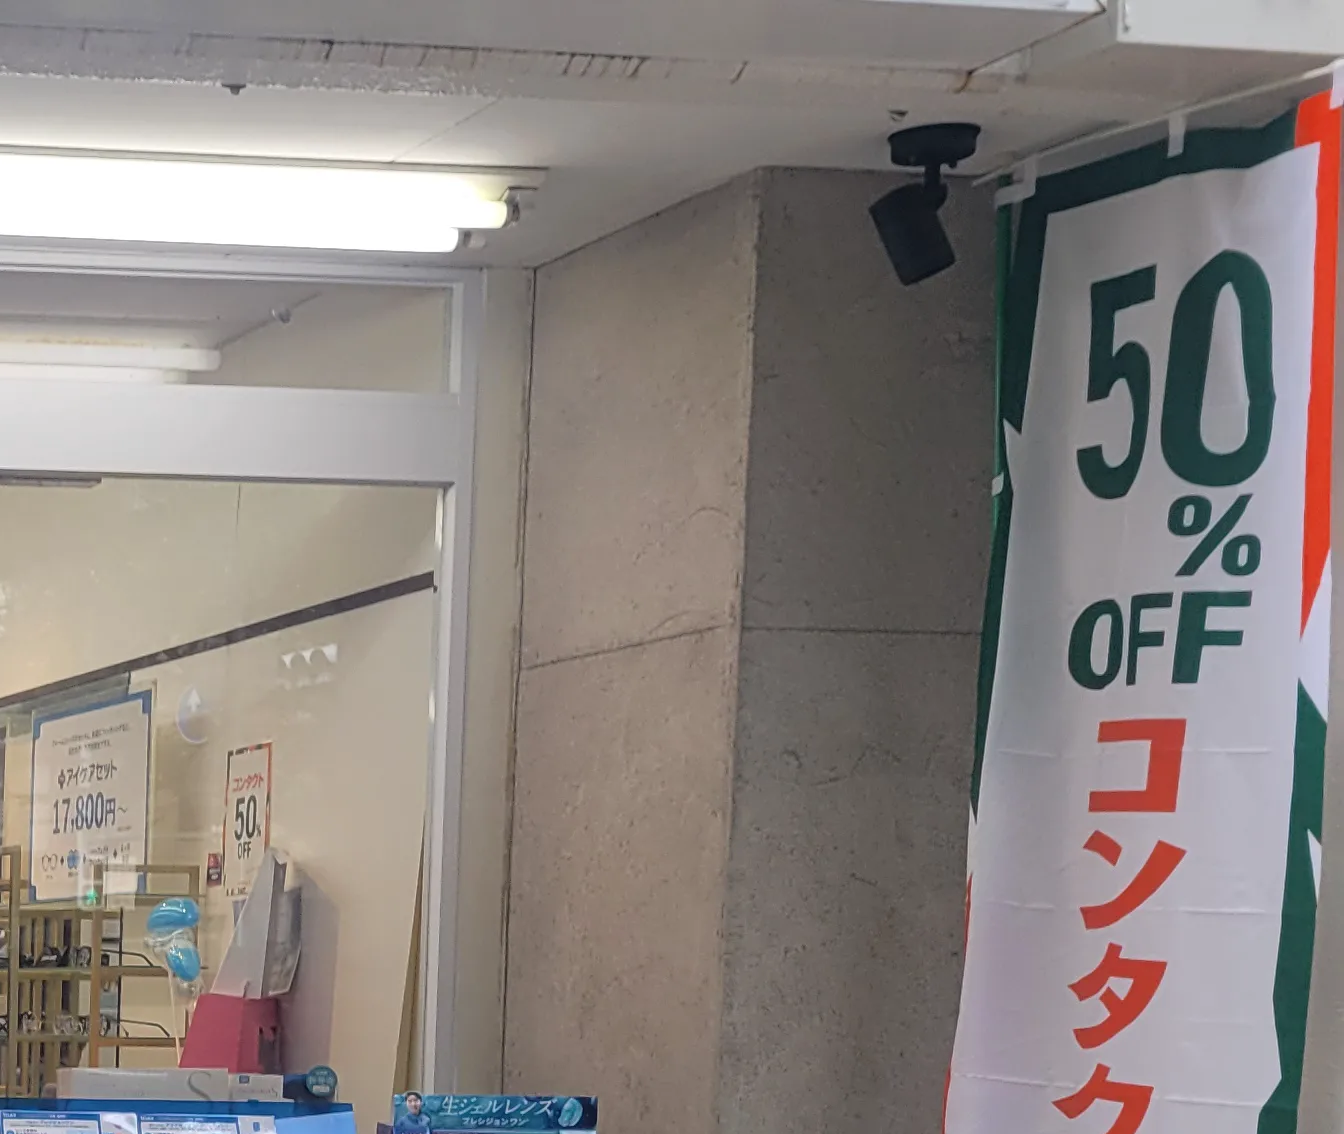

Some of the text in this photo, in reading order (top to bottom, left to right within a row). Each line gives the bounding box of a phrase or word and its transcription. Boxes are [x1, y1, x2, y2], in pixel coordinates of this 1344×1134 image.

[1077, 248, 1277, 501] 50
[1067, 590, 1253, 691] OFF
[237, 841, 252, 860] OFF
[438, 1095, 557, 1116] 生ジェルレンズ
